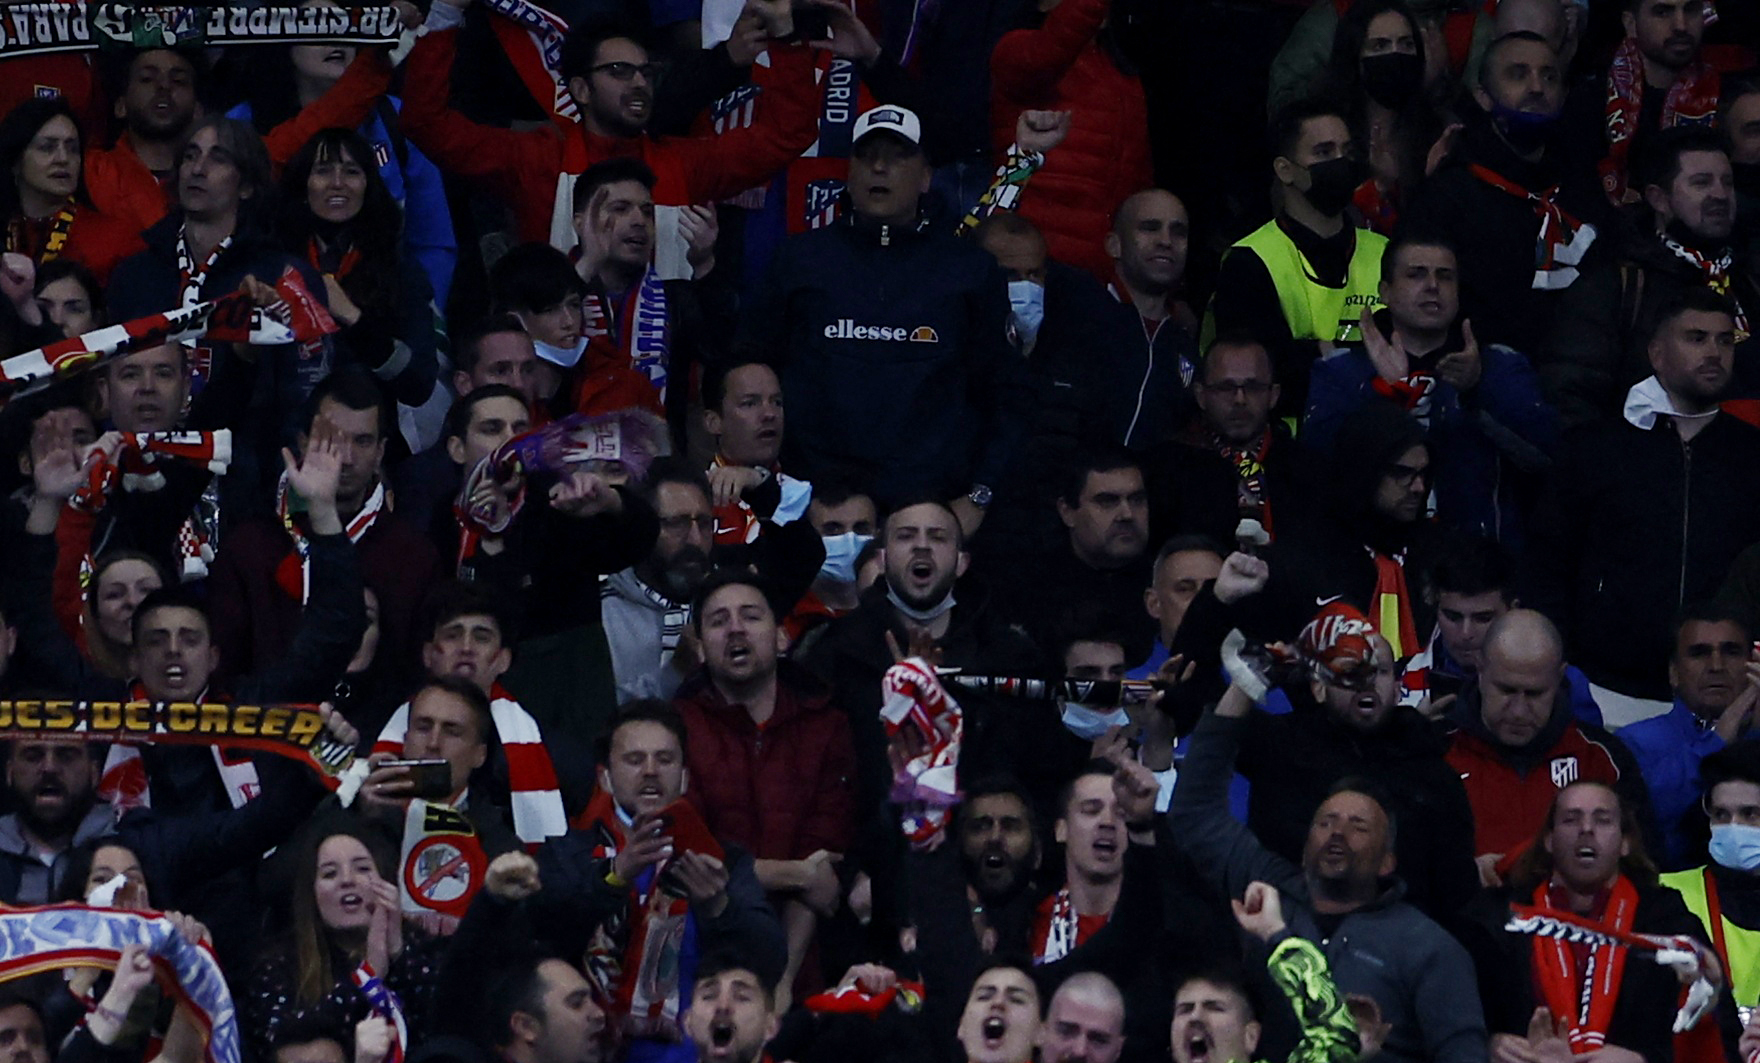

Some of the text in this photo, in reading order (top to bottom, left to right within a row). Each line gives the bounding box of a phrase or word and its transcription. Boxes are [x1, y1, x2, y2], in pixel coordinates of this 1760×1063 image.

[16, 2, 90, 46] PARA
[826, 57, 853, 126] ADRID
[824, 318, 908, 341] ellesse
[91, 701, 151, 731] DE
[168, 701, 324, 746] CREER
